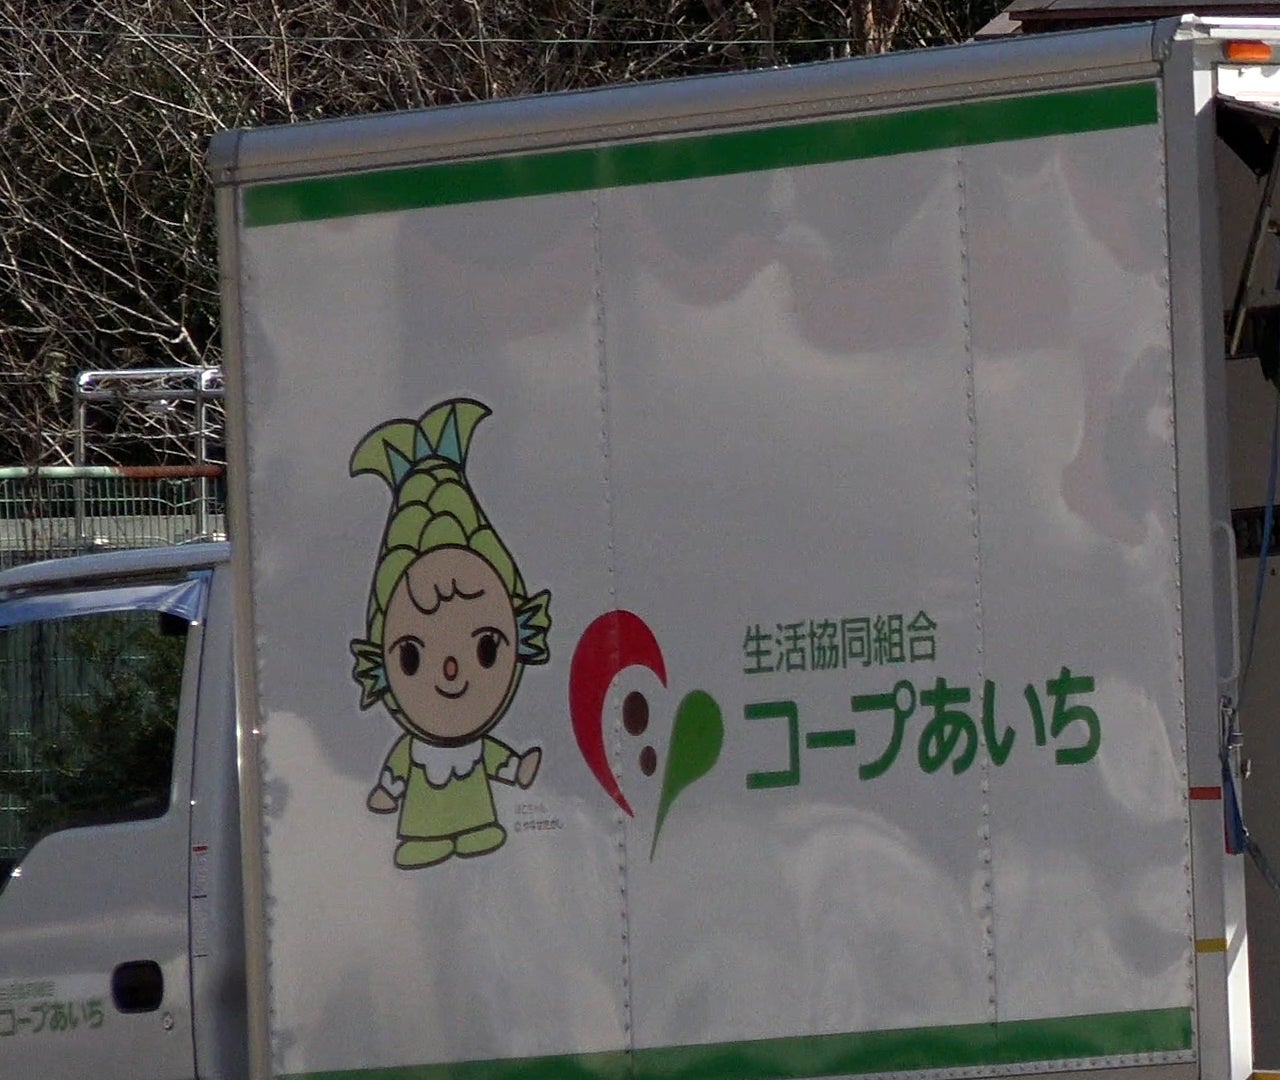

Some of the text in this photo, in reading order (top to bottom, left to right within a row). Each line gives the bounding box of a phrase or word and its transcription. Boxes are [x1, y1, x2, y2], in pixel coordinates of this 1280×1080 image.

[743, 610, 937, 674] 生活協同組合
[744, 666, 1101, 789] コープあいち
